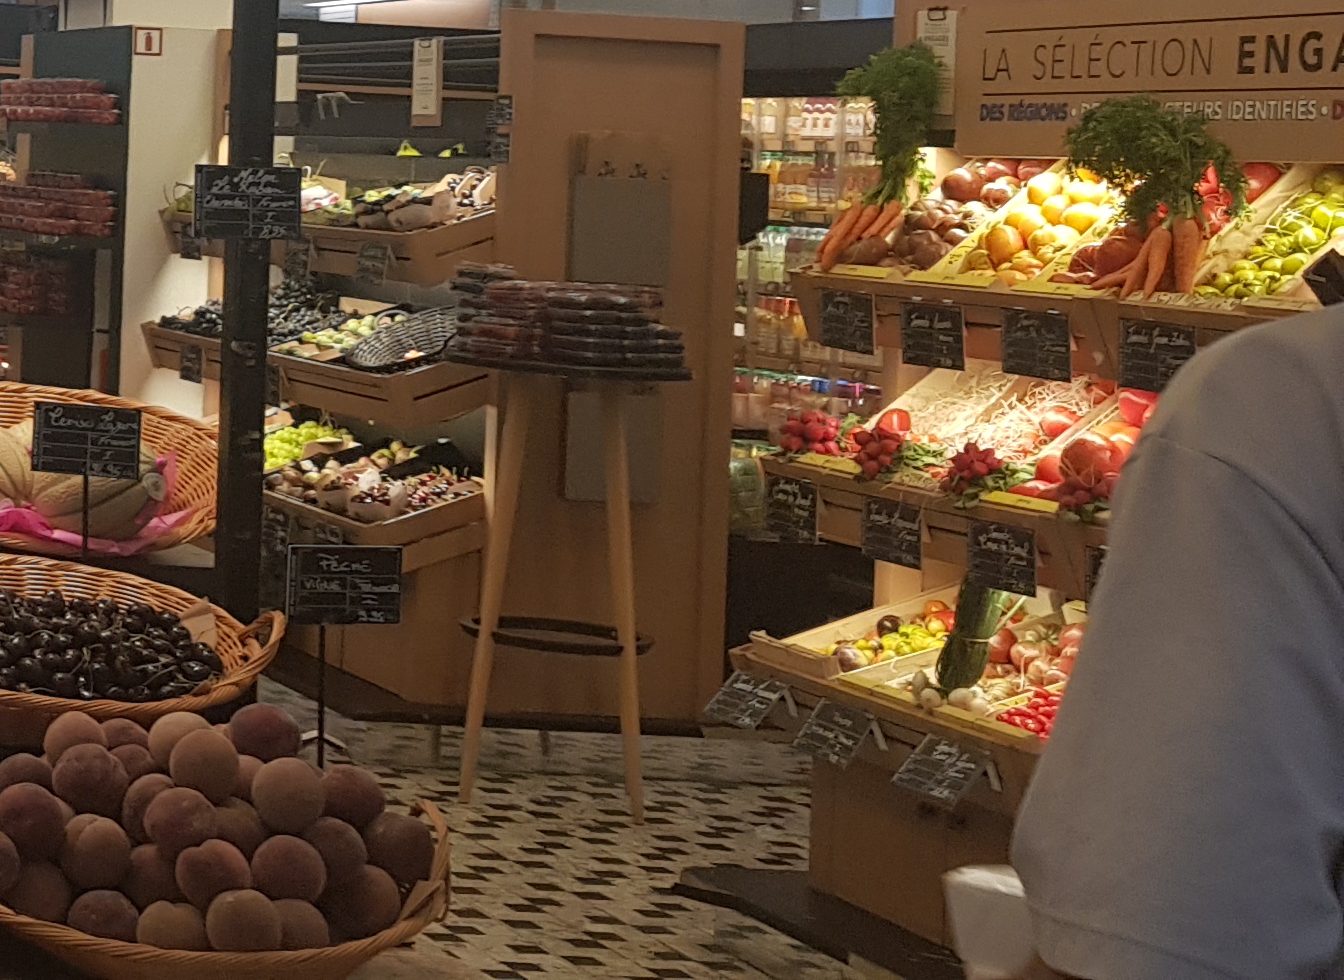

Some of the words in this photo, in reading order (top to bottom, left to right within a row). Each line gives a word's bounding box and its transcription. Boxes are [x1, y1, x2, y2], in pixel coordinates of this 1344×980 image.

[982, 48, 1011, 81] LA
[1031, 34, 1214, 81] SÉLÉCTION
[979, 103, 1005, 122] DES
[1007, 98, 1070, 122] RÉGIONS
[1227, 97, 1317, 121] IDENTIFIÉS
